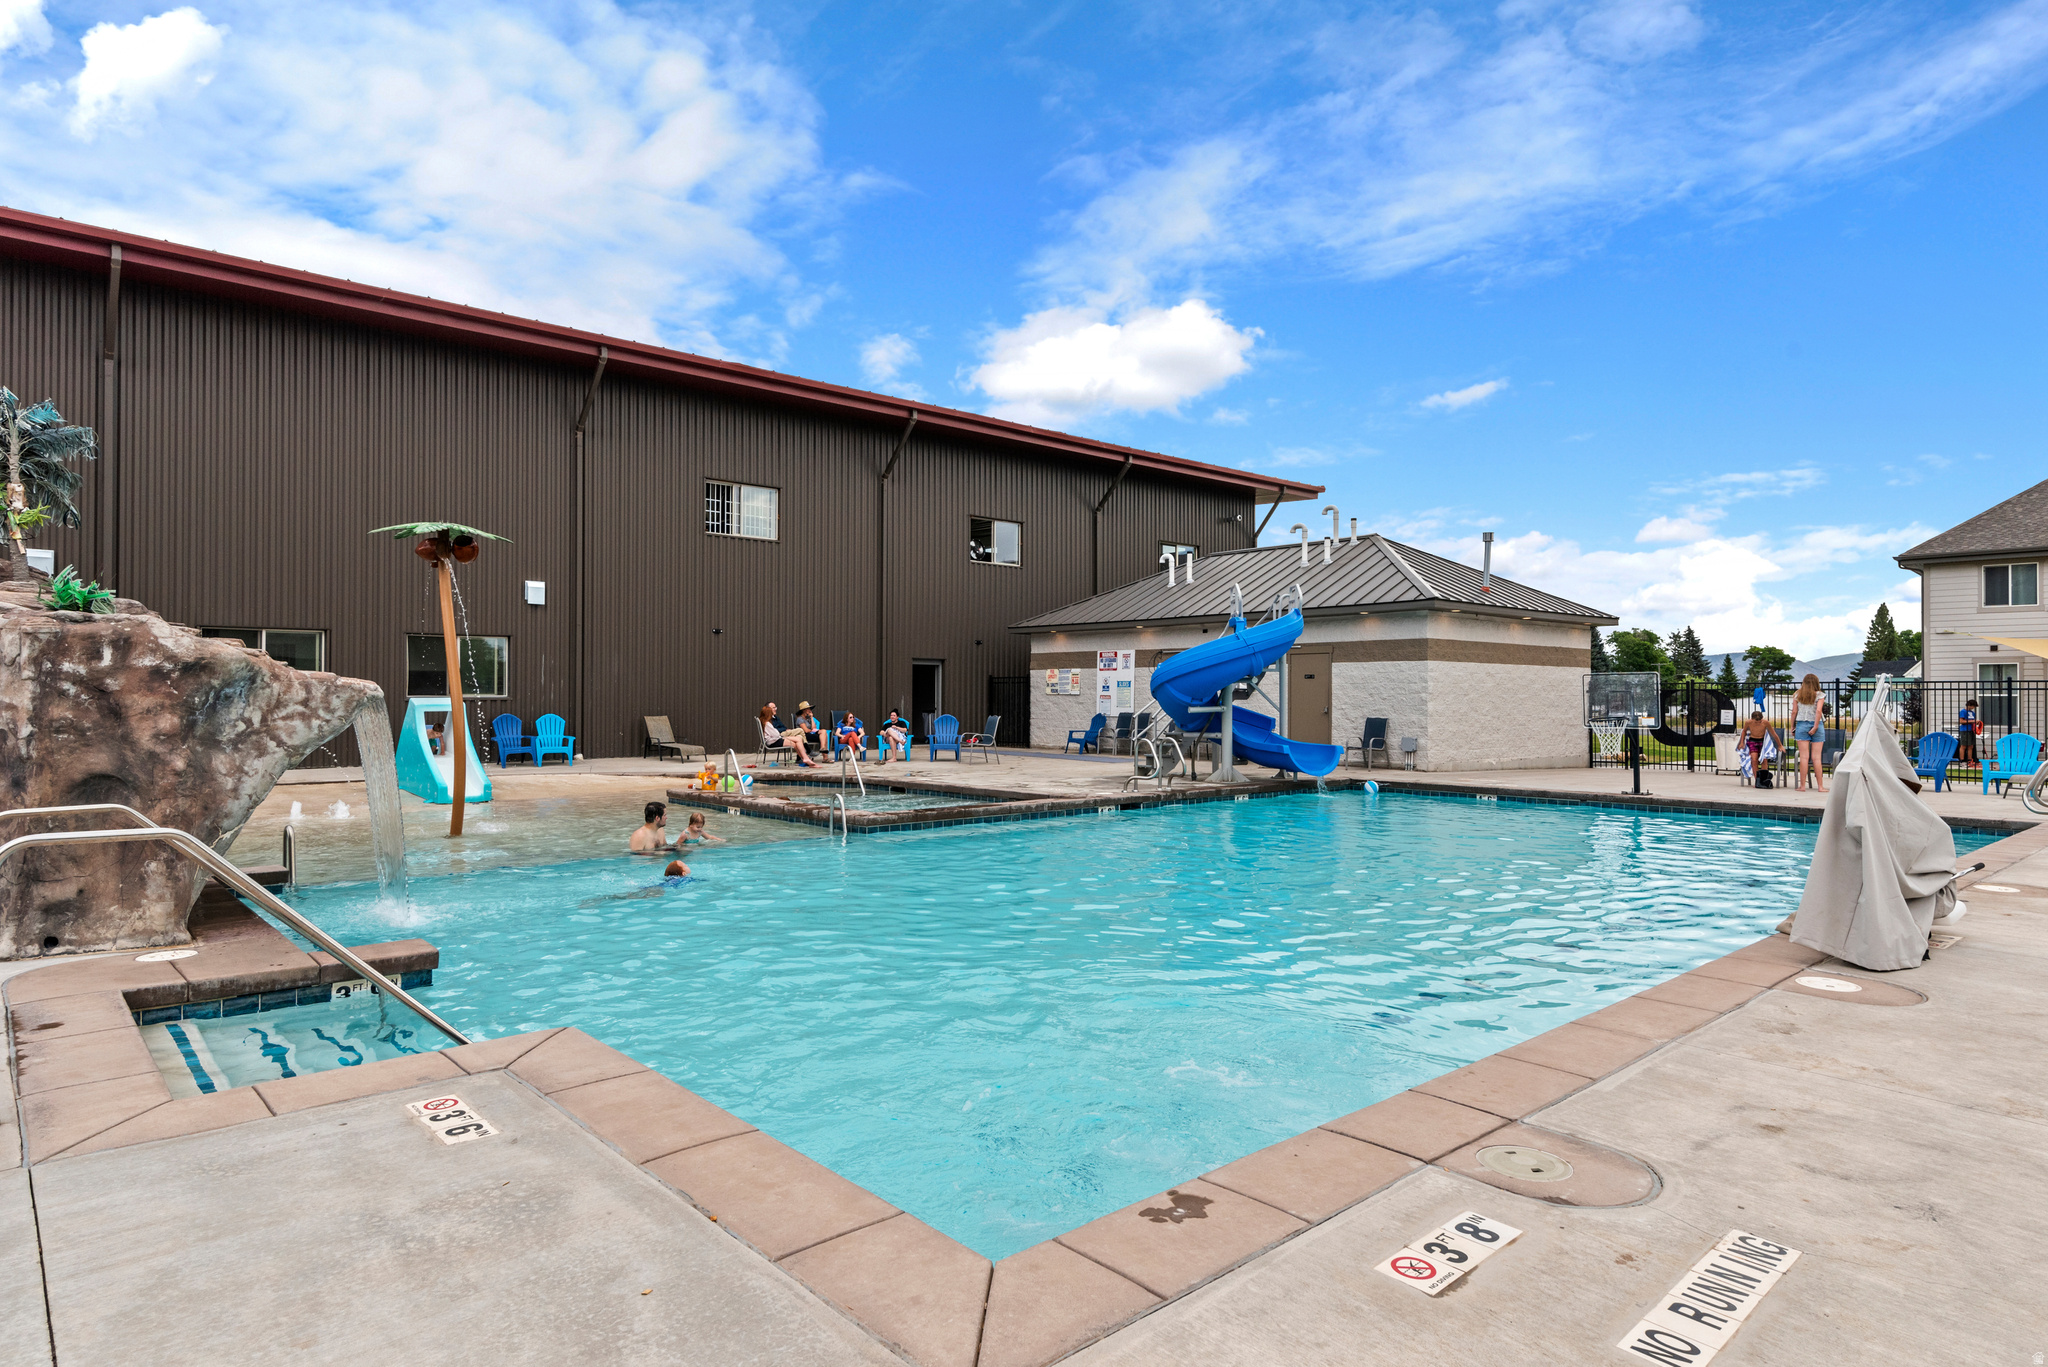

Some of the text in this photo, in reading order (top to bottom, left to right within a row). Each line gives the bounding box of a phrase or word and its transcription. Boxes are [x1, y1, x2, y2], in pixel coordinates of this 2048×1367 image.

[353, 983, 364, 992] FT
[429, 1109, 466, 1122] 3
[445, 1123, 484, 1136] 6
[1423, 1214, 1500, 1264] 3 FT 8 IN
[1428, 1271, 1455, 1290] NO DIVING
[1628, 1235, 1789, 1367] NO RUNNING
